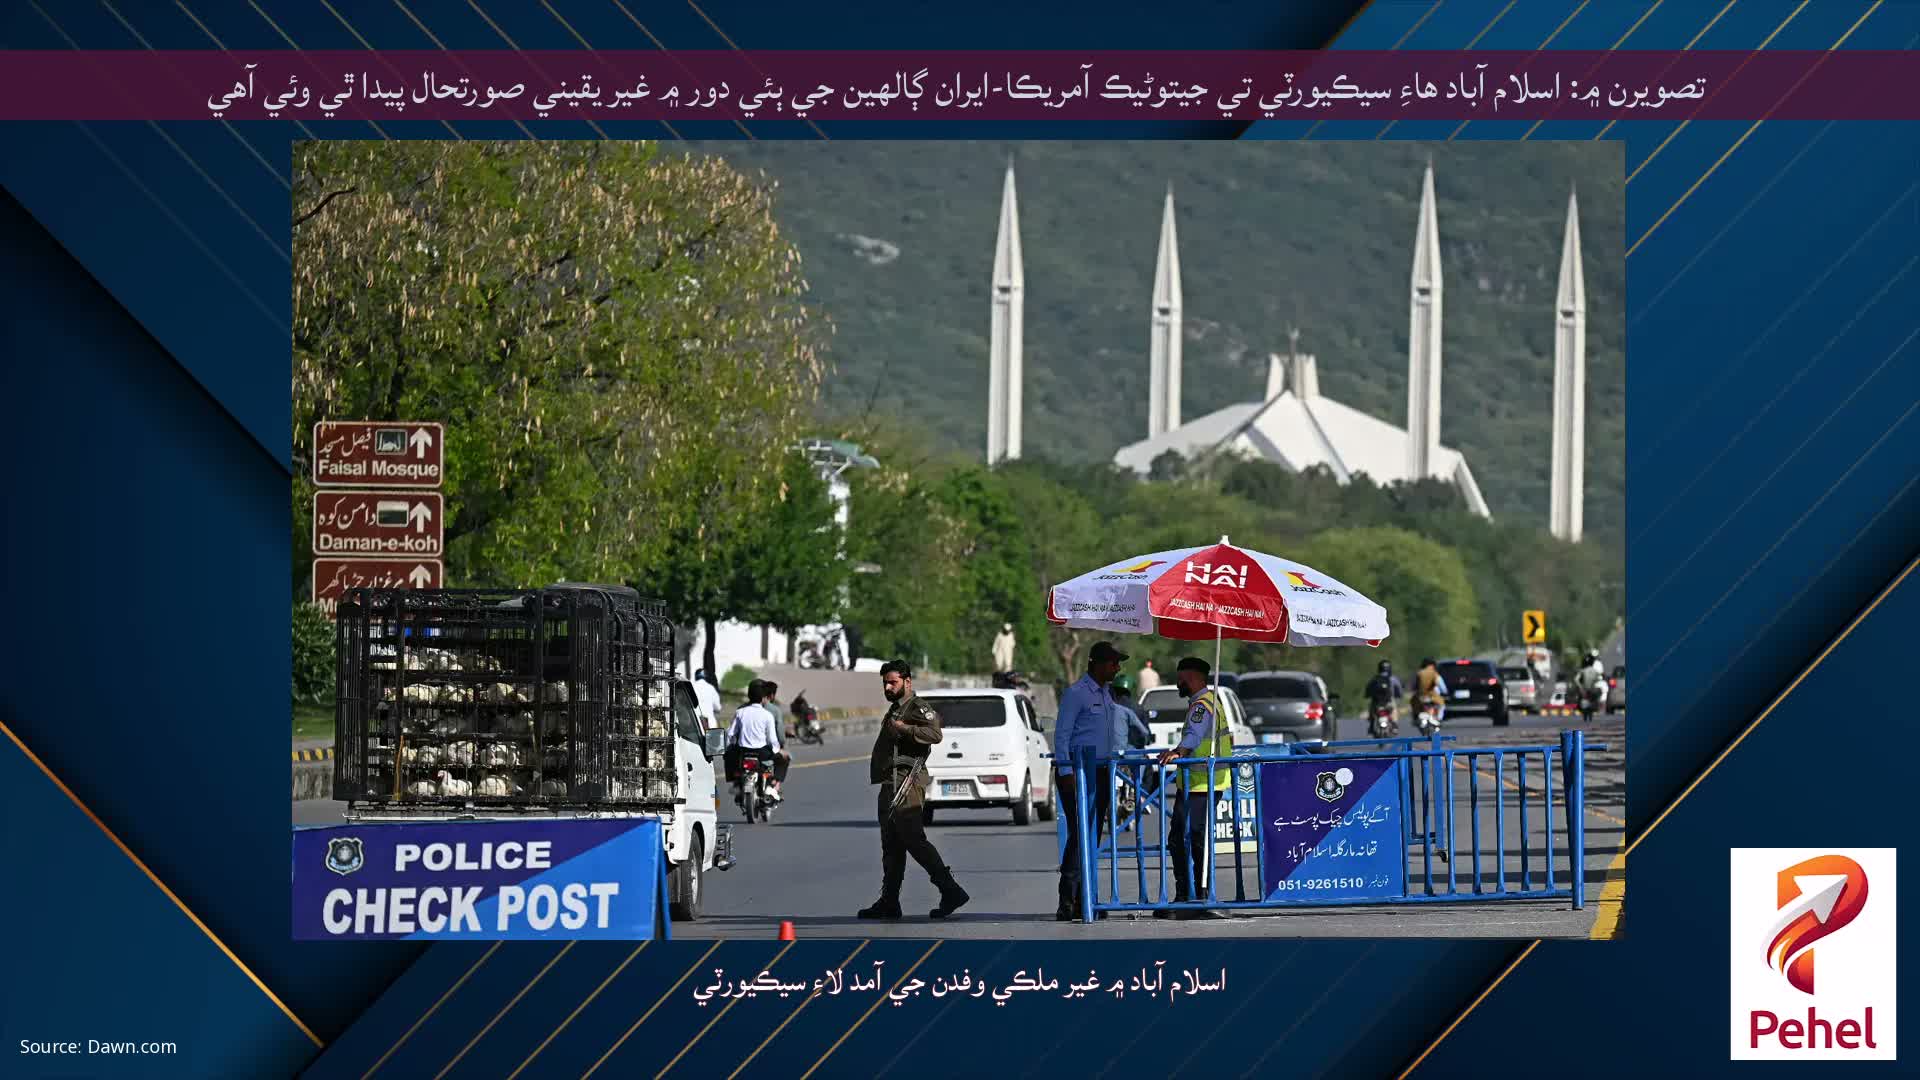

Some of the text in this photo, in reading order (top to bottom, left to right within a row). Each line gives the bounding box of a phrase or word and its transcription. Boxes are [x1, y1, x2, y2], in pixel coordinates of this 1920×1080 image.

[318, 427, 371, 458] فیصل مسجد
[319, 459, 439, 479] Faisal Mosque
[319, 534, 438, 552] Daman-e-koh
[1186, 561, 1248, 577] HAI
[1184, 572, 1247, 589] NA!
[1273, 816, 1290, 832] ہے
[1291, 812, 1320, 831] پوسٹ
[1318, 807, 1342, 828] چیک
[395, 841, 552, 872] POLICE
[1278, 877, 1364, 891] 051-9261510
[323, 882, 620, 934] CHECK POST
